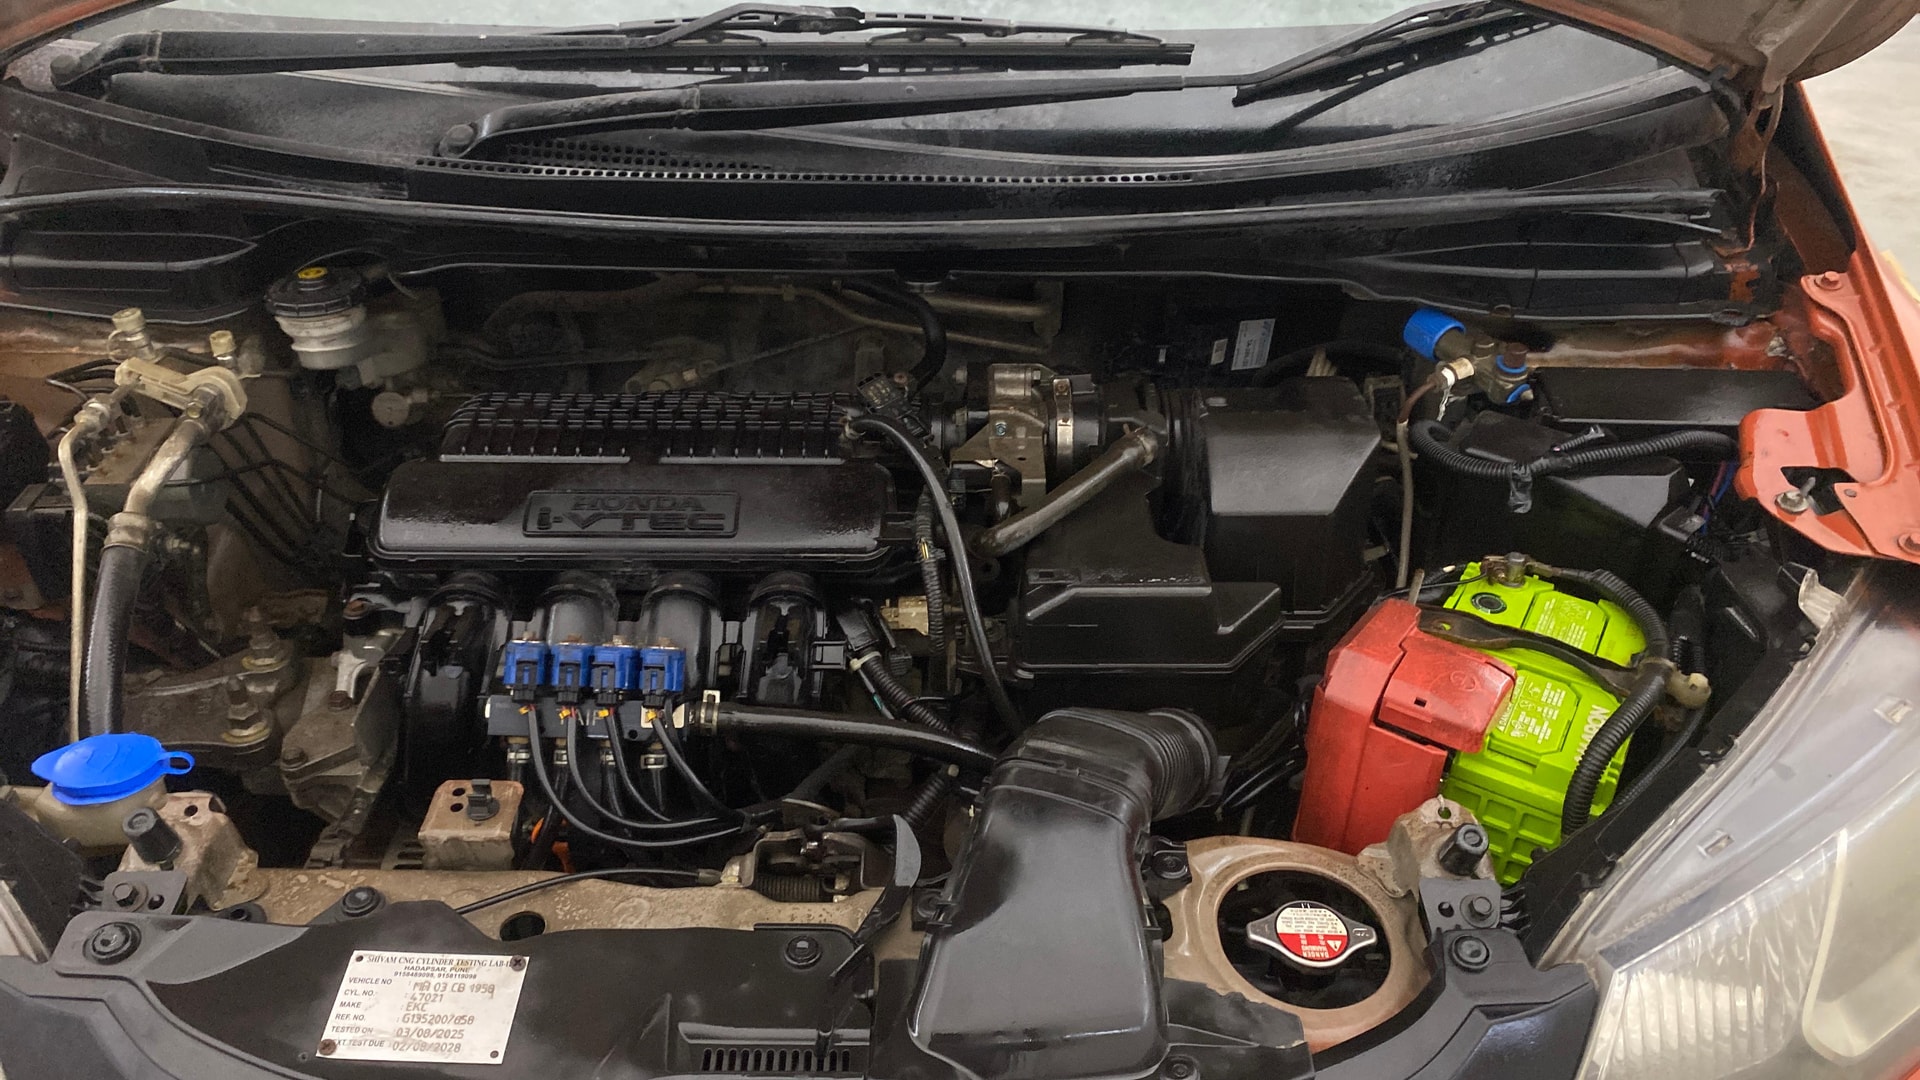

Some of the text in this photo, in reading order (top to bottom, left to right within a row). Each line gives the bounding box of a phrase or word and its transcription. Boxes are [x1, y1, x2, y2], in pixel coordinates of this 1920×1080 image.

[572, 496, 705, 512] HONDA
[367, 956, 397, 964] SHIVAM
[398, 957, 414, 965] CNG
[417, 957, 453, 966] CYLINDER
[456, 959, 487, 967] TESTING
[434, 982, 448, 992] 03
[451, 983, 466, 993] CB
[410, 993, 444, 1002] 47021
[406, 1002, 429, 1012] EKC
[396, 1027, 465, 1039] 03/08/2025
[392, 1041, 461, 1052] 02/08/2028
